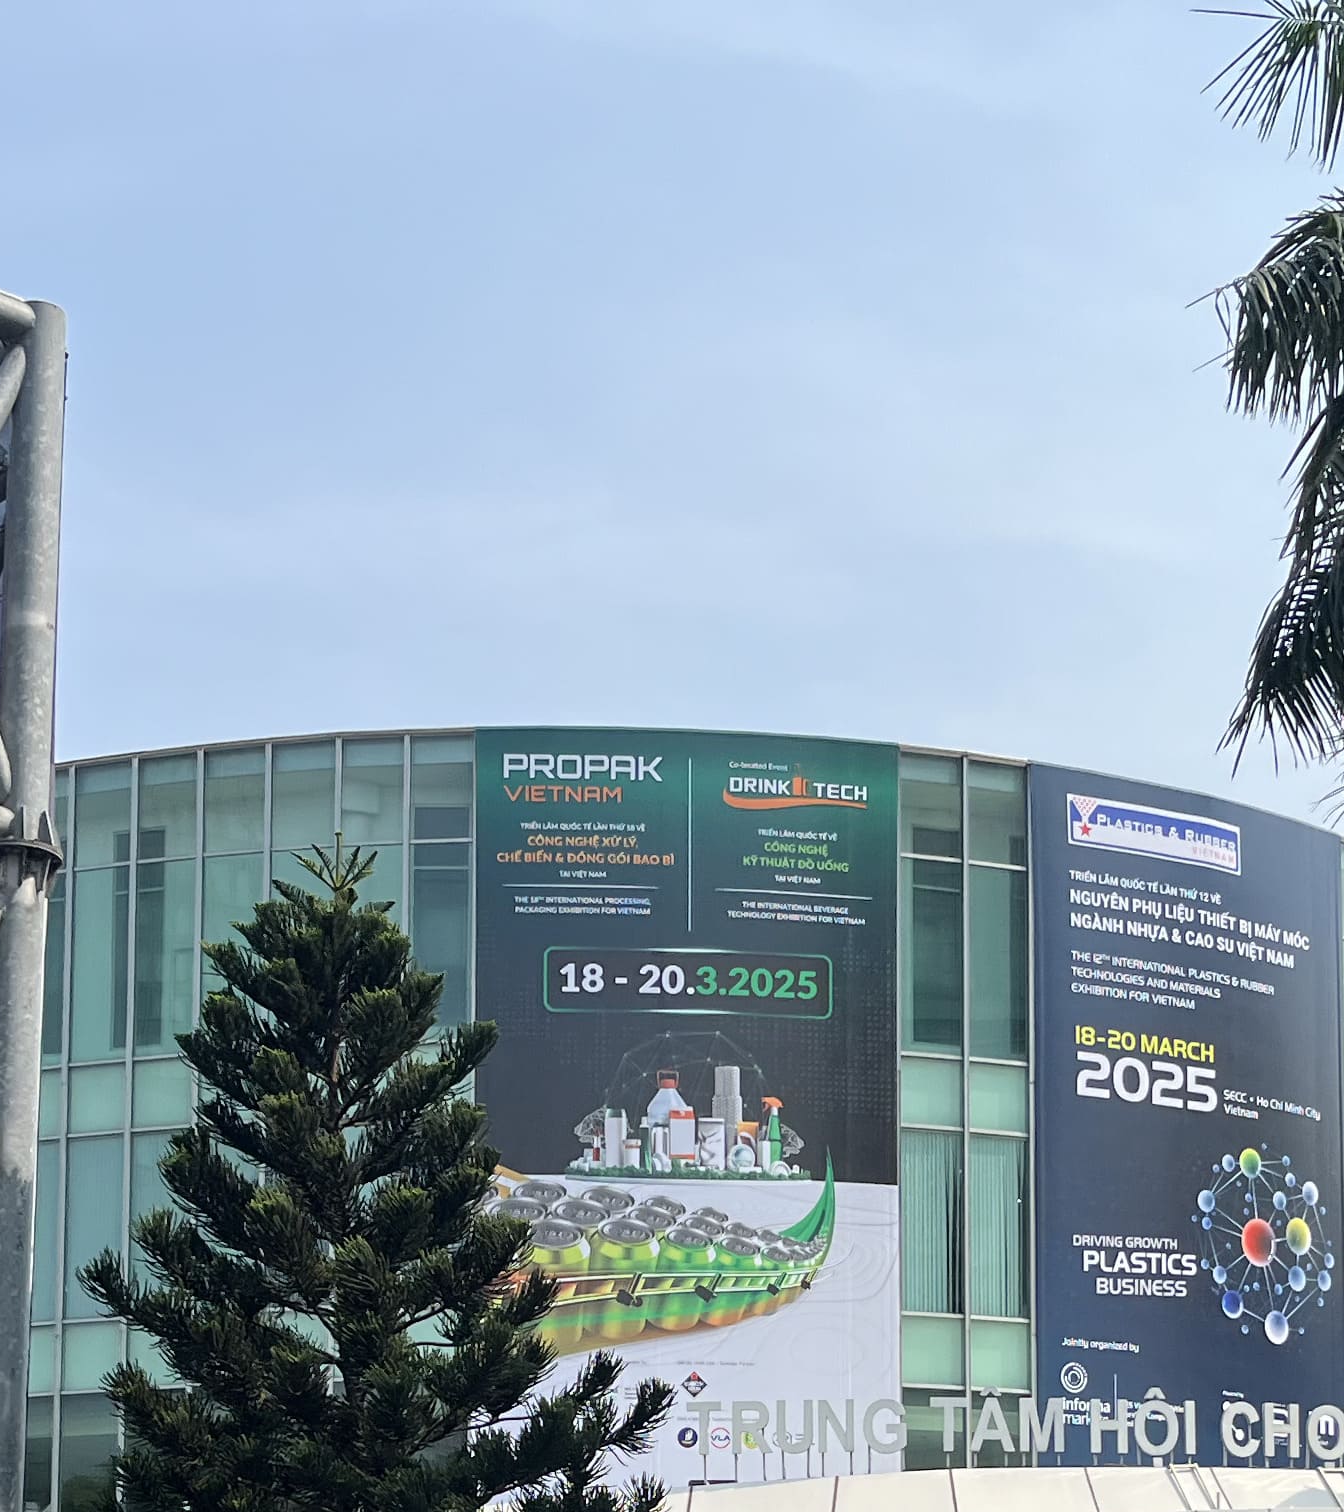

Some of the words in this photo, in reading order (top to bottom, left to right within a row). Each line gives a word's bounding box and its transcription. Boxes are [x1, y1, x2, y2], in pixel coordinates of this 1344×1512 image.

[503, 753, 663, 782] PROPAK
[503, 785, 623, 804] VIETNAM
[729, 776, 791, 796] DRINK
[813, 782, 868, 801] TECH
[527, 833, 563, 847] CÔNG
[633, 854, 660, 865] BAO
[1199, 891, 1209, 903] 12
[1069, 888, 1129, 914] NGUYÊN
[1132, 899, 1162, 920] PHỤ
[1165, 902, 1195, 925] LIỆU
[1197, 908, 1236, 932] THIẾT
[1239, 915, 1253, 938] BỊ
[1255, 918, 1281, 944] MÁY
[1283, 924, 1310, 951] MÓC
[1070, 911, 1124, 936] NGÀNH
[1127, 921, 1168, 944] NHỰA
[1171, 928, 1182, 944] &
[1185, 930, 1214, 950] CAO
[1216, 936, 1234, 954] SU
[1236, 938, 1265, 962] VIỆT
[1266, 948, 1295, 968] NAM
[558, 962, 605, 994] 18
[639, 964, 818, 1000] 20.3.2025
[1071, 951, 1091, 964] THE
[1112, 956, 1186, 978] INTERNATIONAL
[1188, 968, 1231, 986] PLASTICS
[1240, 979, 1275, 996] RUBBER
[1071, 967, 1145, 988] TECHNOLOGIES
[1147, 976, 1168, 990] AND
[1170, 979, 1221, 999] MATERIALS
[1071, 982, 1127, 1000] EXHIBITION
[1129, 990, 1149, 1003] FOR
[1152, 993, 1195, 1010] VIETNAM
[1075, 1025, 1136, 1050] 18-20
[1140, 1035, 1215, 1063] MARCH
[1075, 1051, 1218, 1113] 2025
[1223, 1088, 1247, 1104] SECC
[1256, 1095, 1268, 1108] Ho
[1270, 1098, 1283, 1112] Chi
[1285, 1102, 1304, 1116] Minh
[1305, 1105, 1321, 1122] City
[1224, 1104, 1258, 1120] Vietnam
[1073, 1234, 1123, 1249] DRIVING
[1125, 1236, 1178, 1250] GROWTH
[1082, 1250, 1197, 1276] PLASTICS
[1096, 1277, 1187, 1297] BUSINESS
[1129, 1342, 1140, 1354] by
[686, 1398, 907, 1456] TRUNG
[930, 1386, 1065, 1454] TÂM
